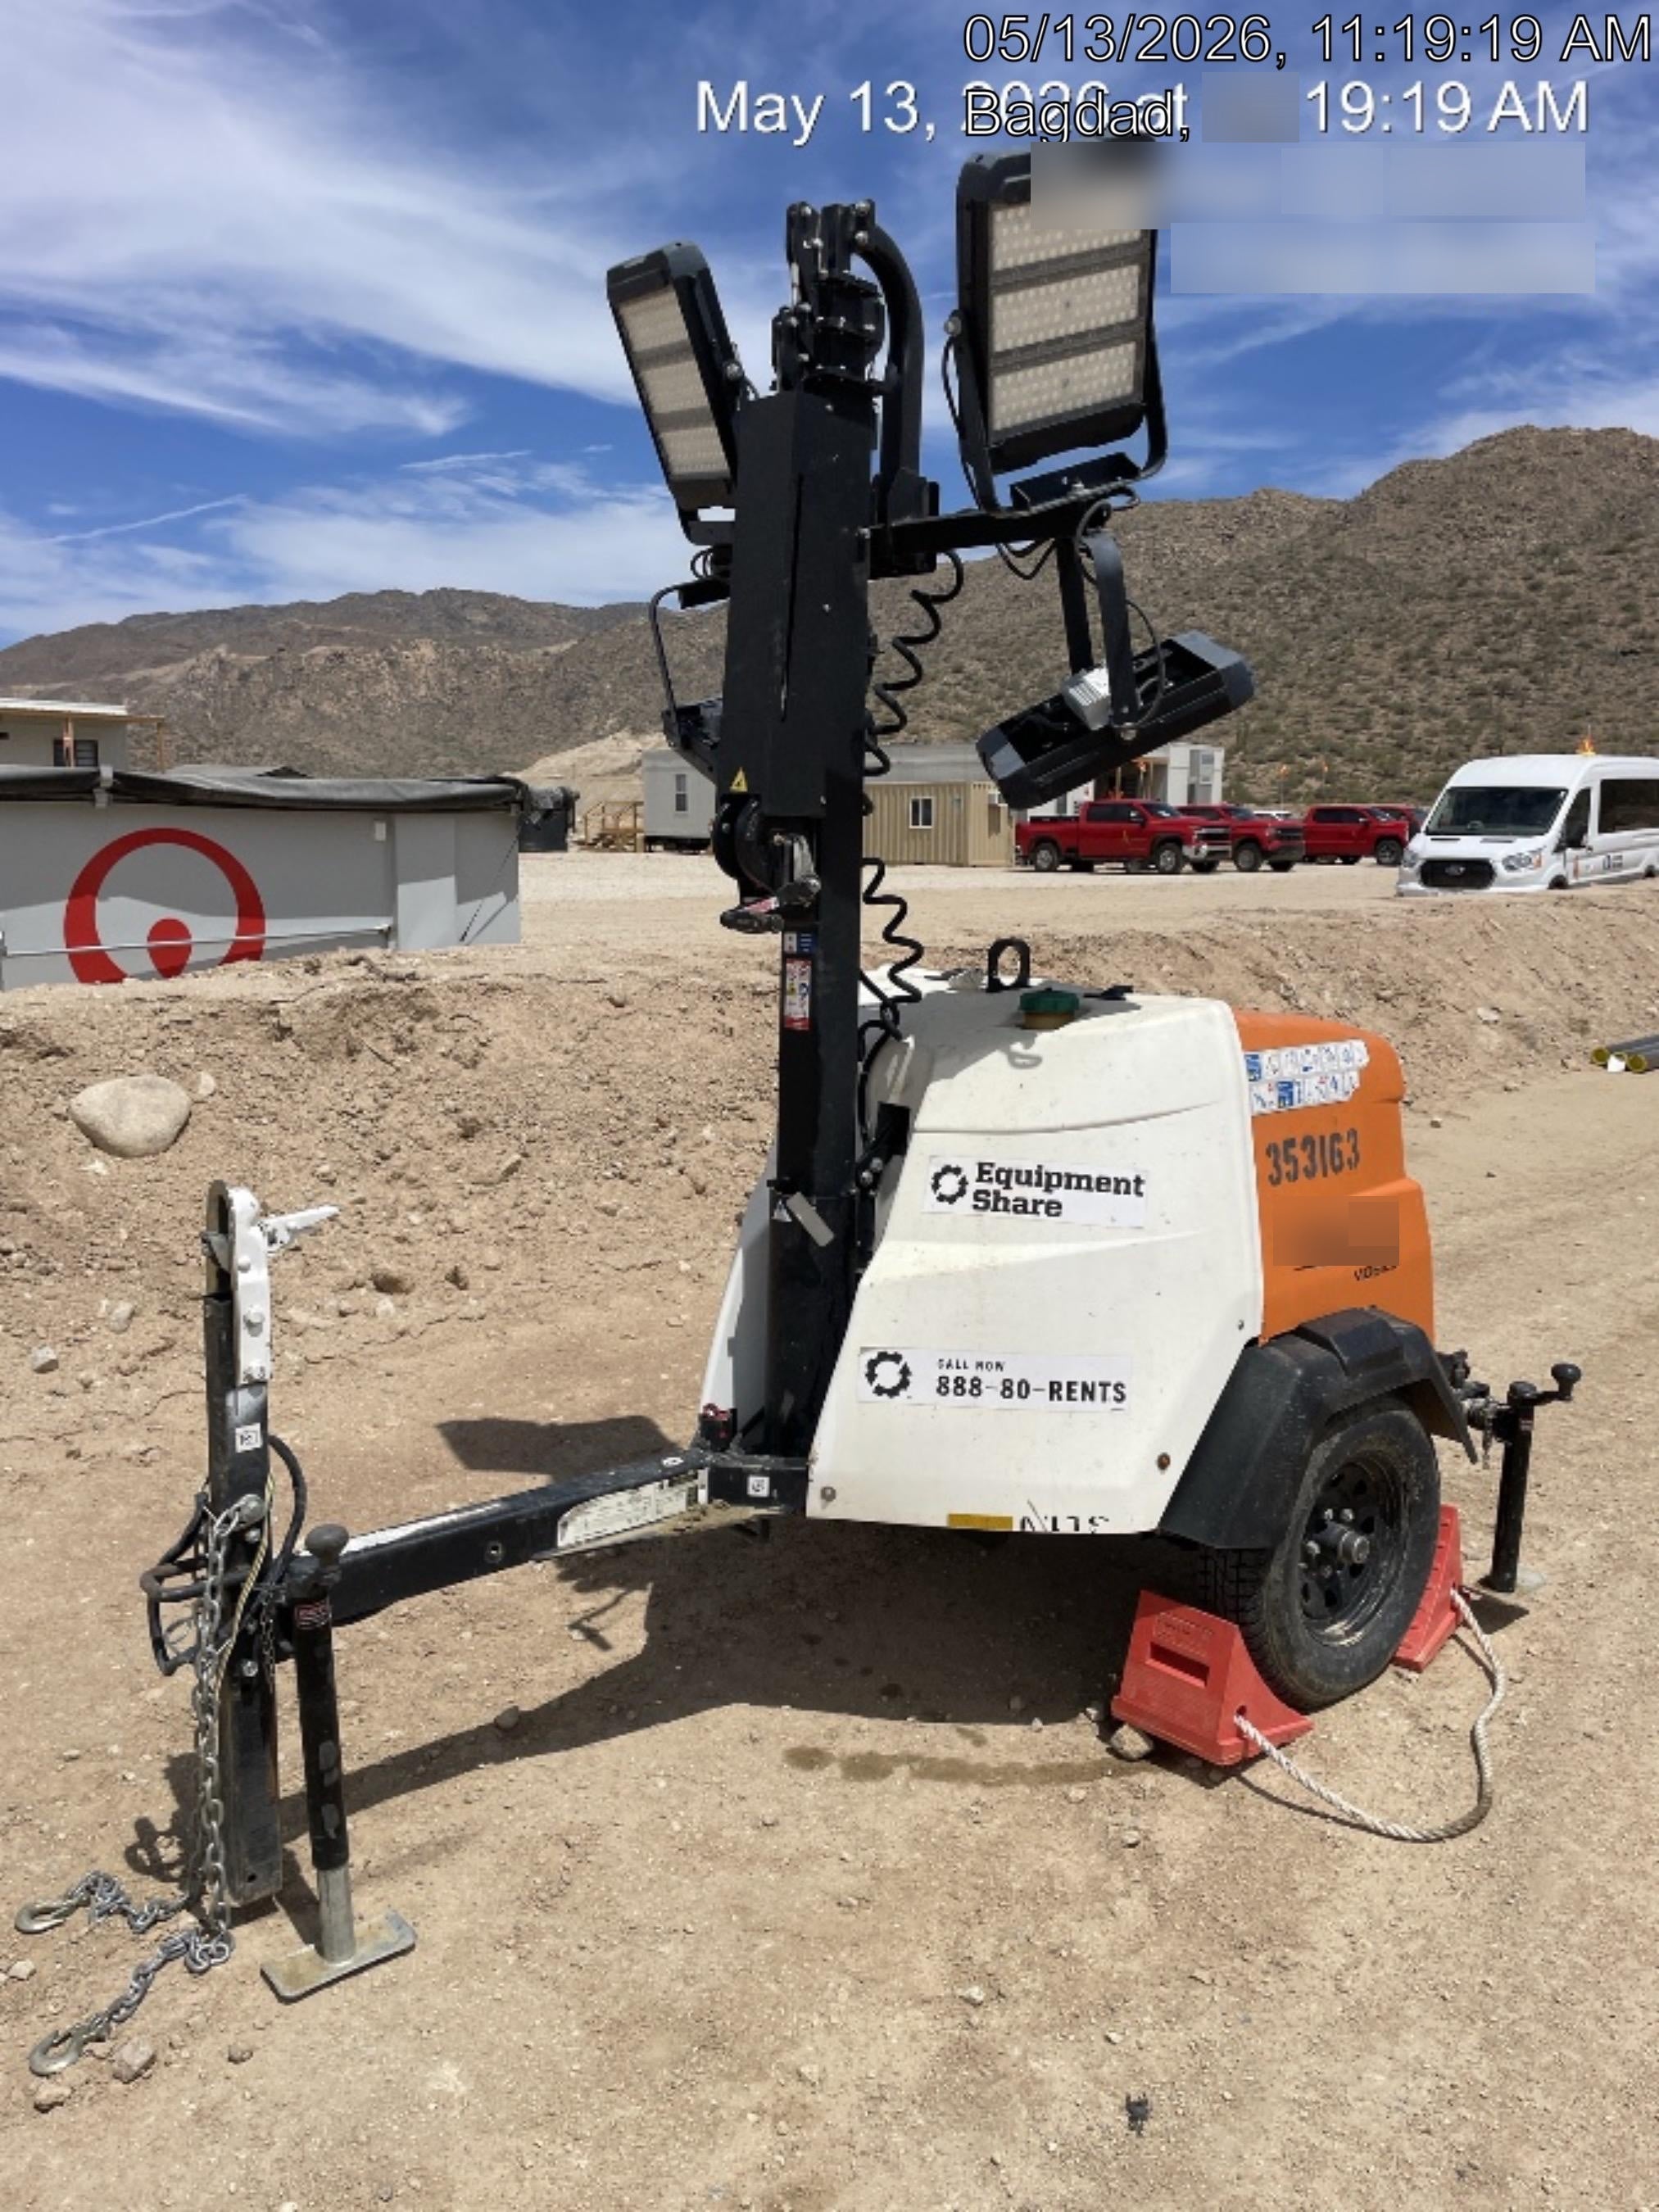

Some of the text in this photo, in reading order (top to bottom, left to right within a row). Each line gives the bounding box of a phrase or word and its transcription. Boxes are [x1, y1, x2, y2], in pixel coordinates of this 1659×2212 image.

[1266, 1127, 1361, 1187] 353163
[975, 1162, 1145, 1197] Equipment
[972, 1189, 1063, 1217] Share
[936, 1376, 1126, 1403] 888-80-RENTS
